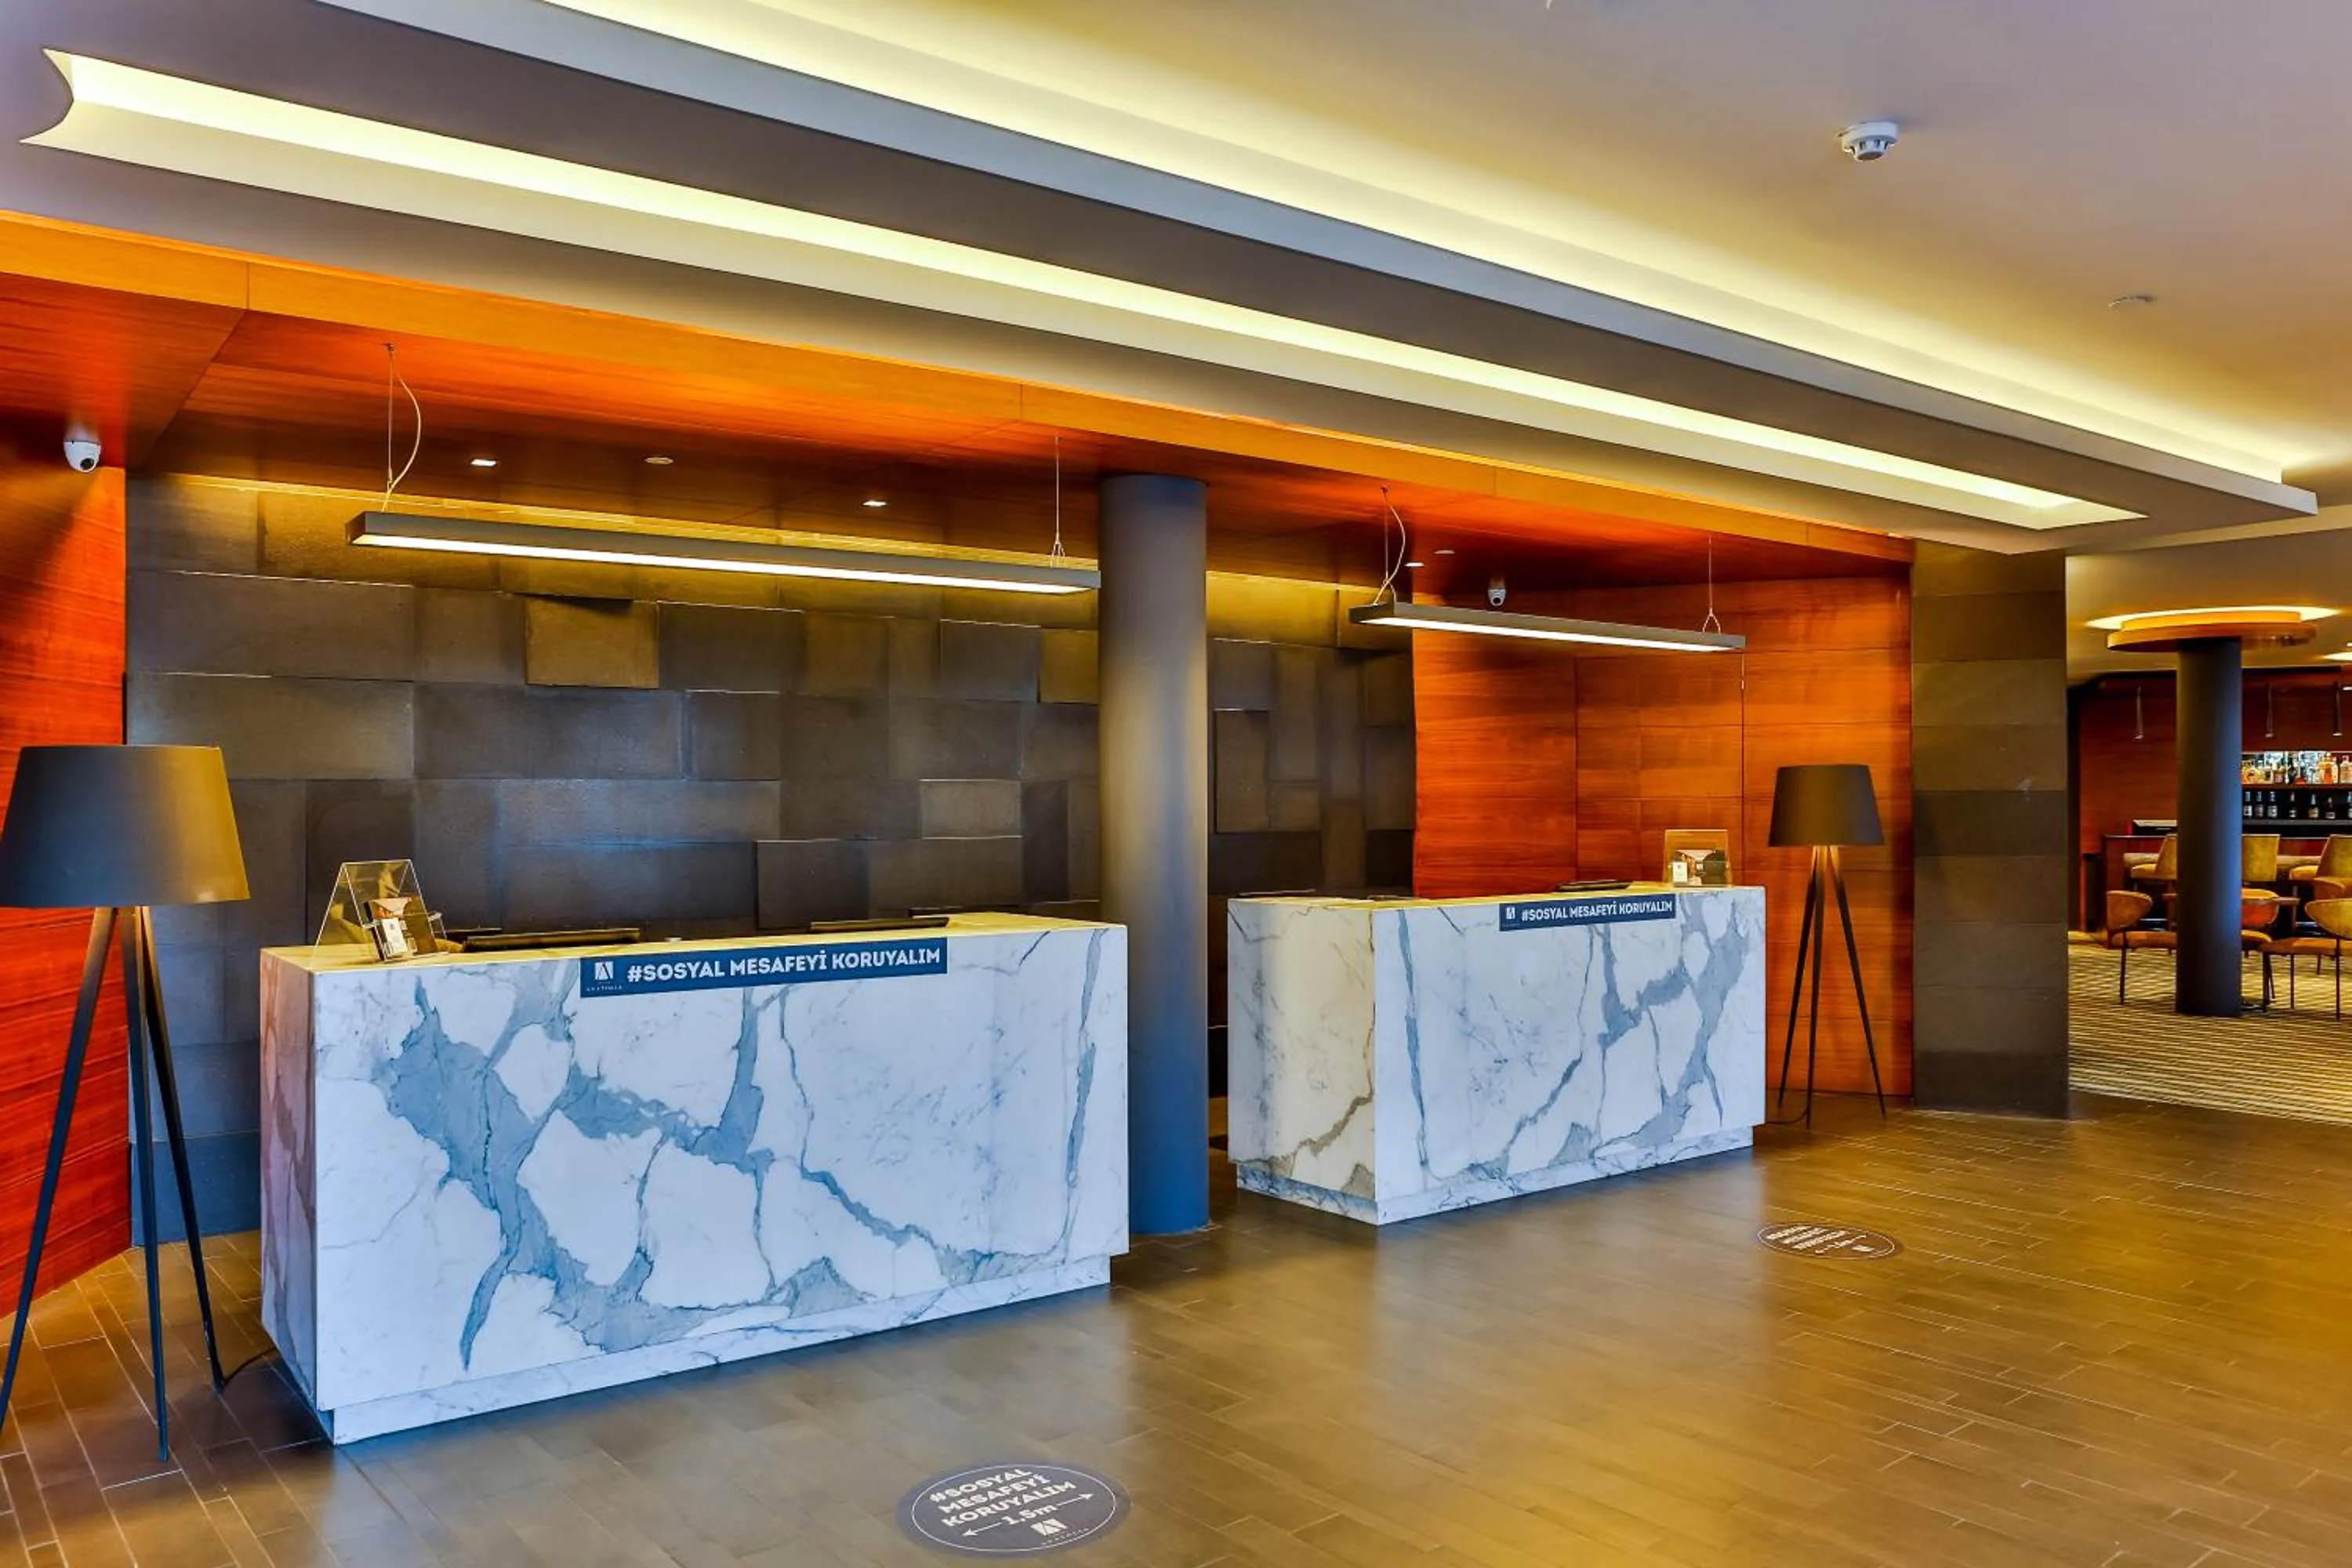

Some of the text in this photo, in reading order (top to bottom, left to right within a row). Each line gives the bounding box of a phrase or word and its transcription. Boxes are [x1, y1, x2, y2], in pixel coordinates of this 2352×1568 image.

[1522, 901, 1672, 921] #SOSYAL MESAFEYİ KORUYALIM
[627, 947, 941, 982] #SOSYAL MESAFEYİ KORUYALIM
[930, 1468, 1033, 1503] #SOSYAL
[938, 1473, 1051, 1514] MESAFEYİ
[942, 1481, 1077, 1527] KORUYALIM
